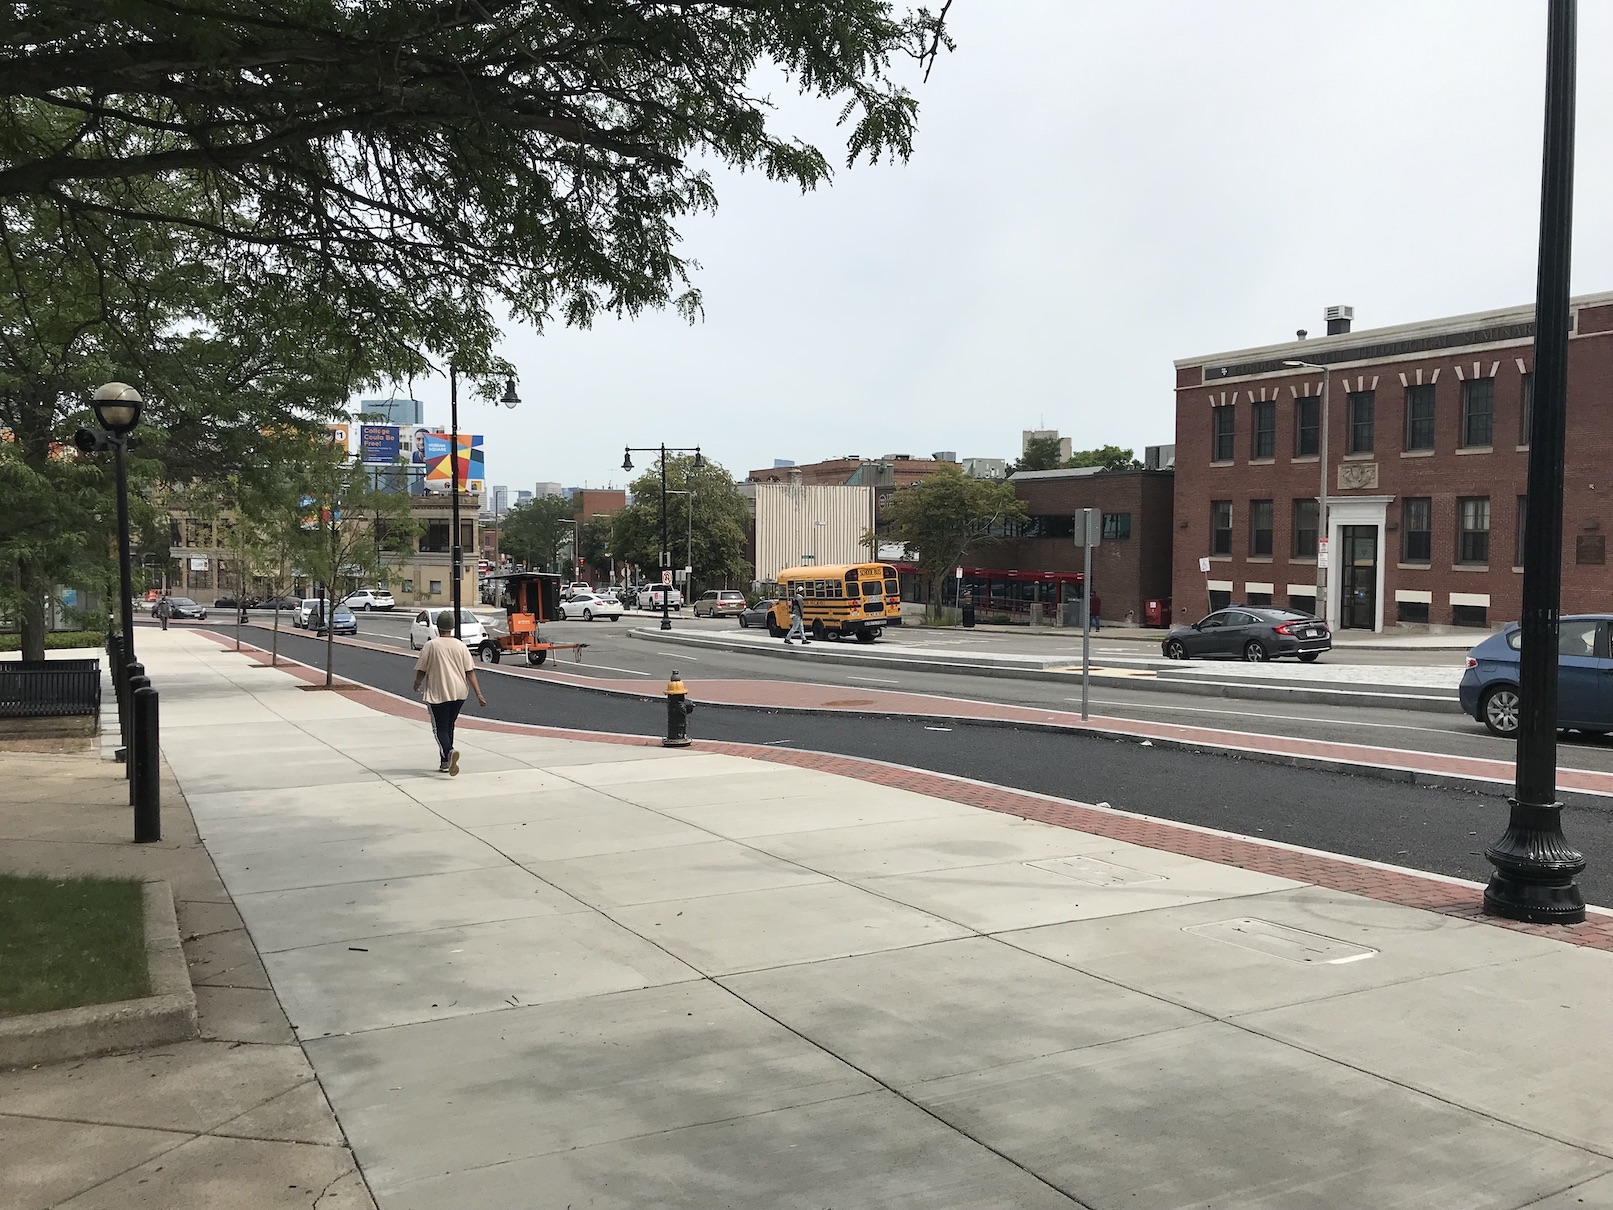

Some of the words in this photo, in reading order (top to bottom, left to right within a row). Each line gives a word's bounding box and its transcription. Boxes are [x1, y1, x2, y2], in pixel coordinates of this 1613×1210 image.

[1463, 324, 1534, 342] SEMINAR
[364, 427, 391, 436] College
[859, 568, 873, 577] SCHOOL
[874, 567, 882, 576] BUS
